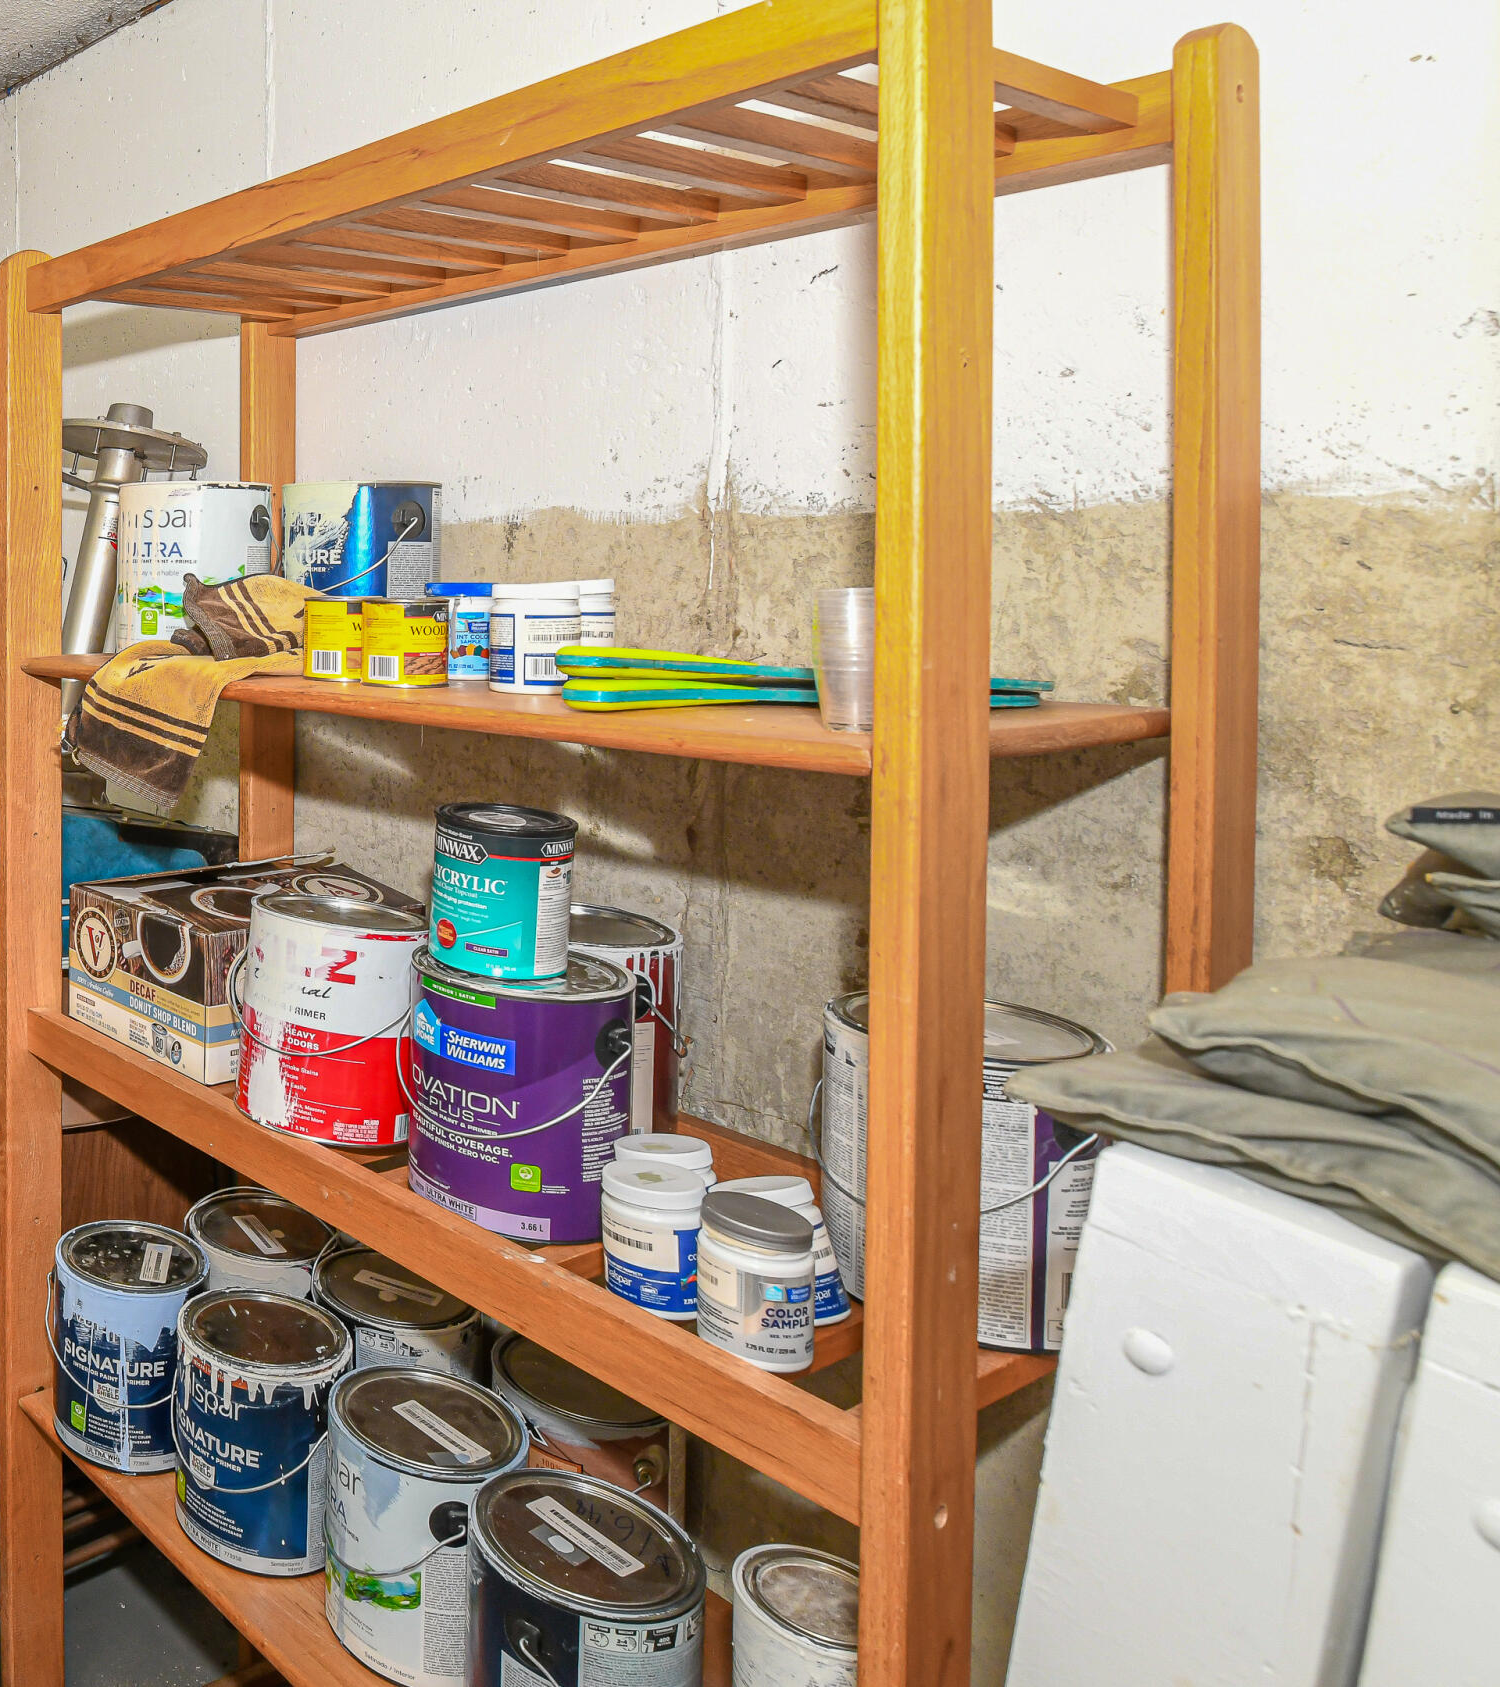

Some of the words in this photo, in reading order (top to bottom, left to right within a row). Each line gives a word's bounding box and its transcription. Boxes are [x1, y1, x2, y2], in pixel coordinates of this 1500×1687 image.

[129, 979, 157, 1002] DECAF
[458, 992, 476, 1001] SATIN
[129, 996, 152, 1016] DONUT
[152, 1007, 172, 1027] SHOP
[172, 1017, 197, 1036] BLEND
[289, 1005, 327, 1021] RIMER
[155, 1036, 164, 1050] 80
[285, 1027, 316, 1041] HEAVY
[287, 1036, 319, 1051] ODORS
[447, 1030, 506, 1056] SHERWIN
[446, 1043, 506, 1070] WILLIAMS
[412, 1063, 517, 1119] OVATION
[429, 1095, 475, 1123] PLUS
[412, 1108, 447, 1139] BEAUTIFUL
[448, 1131, 513, 1158] COVERAGE.
[438, 1111, 458, 1126] PAINT
[467, 1124, 498, 1137] PRIMER
[416, 1122, 435, 1141] LASTING
[434, 1135, 457, 1152] FINISH.
[457, 1145, 479, 1159] ZERO
[479, 1152, 500, 1165] VOC.
[426, 1186, 447, 1204] ULTRA
[449, 1197, 475, 1215] WHITE
[521, 1221, 537, 1232] 3.66
[761, 1316, 810, 1329] SAMPLE
[765, 1307, 808, 1319] COLOR
[64, 1336, 165, 1379] SIGNATURE
[72, 1361, 99, 1379] INTEROR
[100, 1372, 118, 1384] PAINT
[215, 1457, 242, 1473] PRIMER
[229, 1524, 244, 1533] COLOR
[200, 1536, 219, 1551] WHITE
